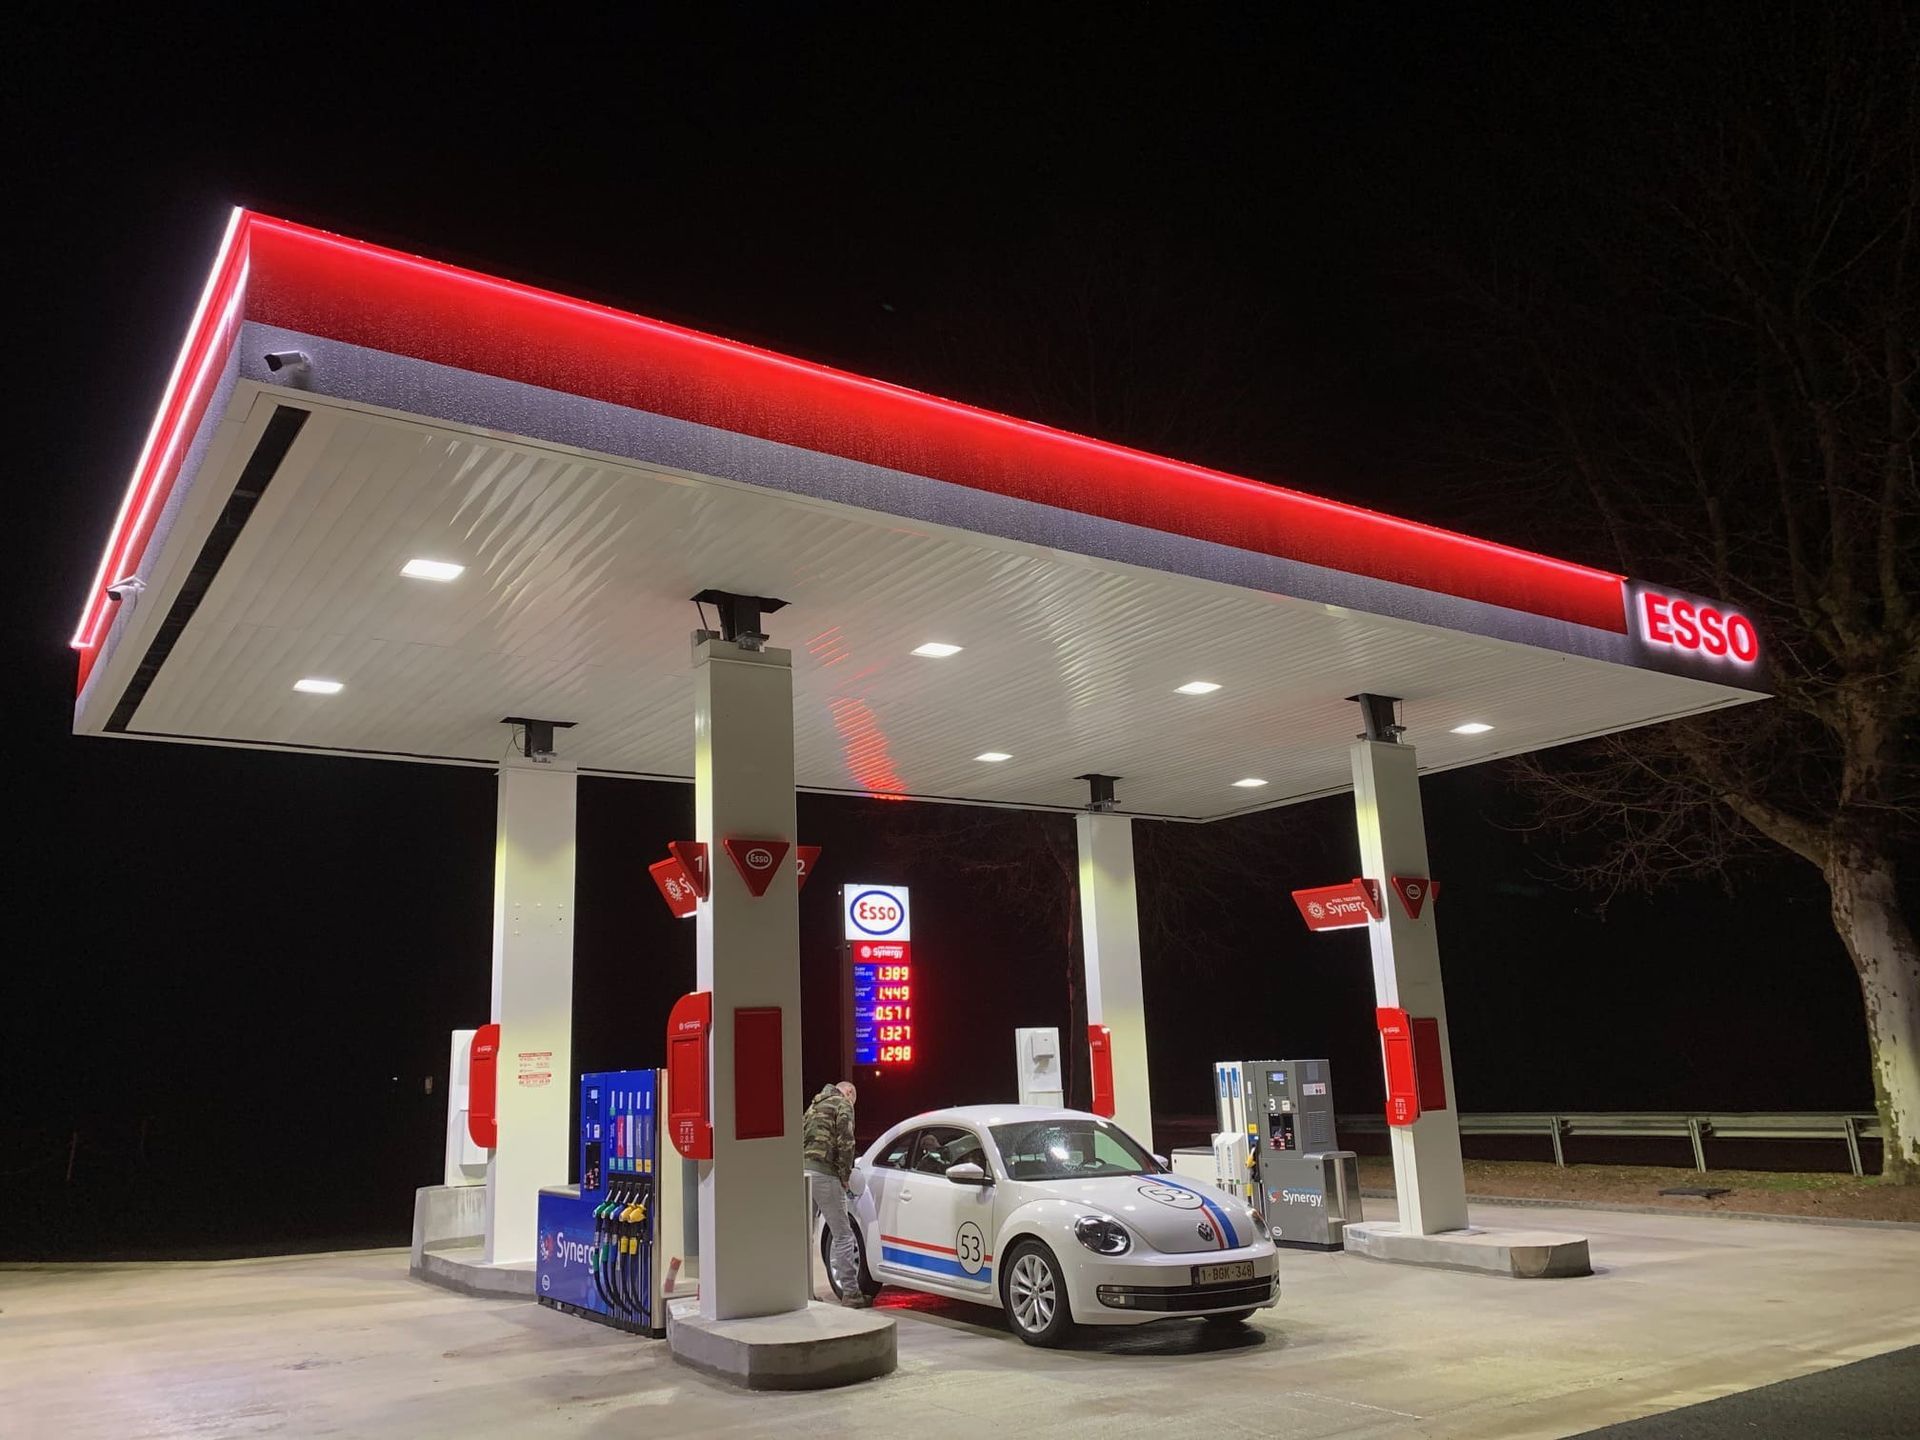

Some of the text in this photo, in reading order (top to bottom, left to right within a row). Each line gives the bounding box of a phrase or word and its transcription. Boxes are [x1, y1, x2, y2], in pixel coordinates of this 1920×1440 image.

[1641, 592, 1759, 662] ESSO
[694, 855, 703, 873] 1
[797, 859, 806, 876] 2
[1371, 888, 1378, 901] 3
[872, 947, 904, 960] Synergy
[878, 966, 910, 981] 1.389
[879, 985, 910, 1001] 1.449
[875, 1006, 911, 1021] 0.571
[880, 1026, 911, 1041] 1.327
[880, 1046, 912, 1062] 1.298
[1269, 1098, 1276, 1111] 3
[585, 1122, 590, 1139] 1
[1148, 1188, 1194, 1202] 53
[1282, 1189, 1322, 1208] Synergy
[556, 1232, 603, 1274] Synerg
[961, 1235, 981, 1262] 53
